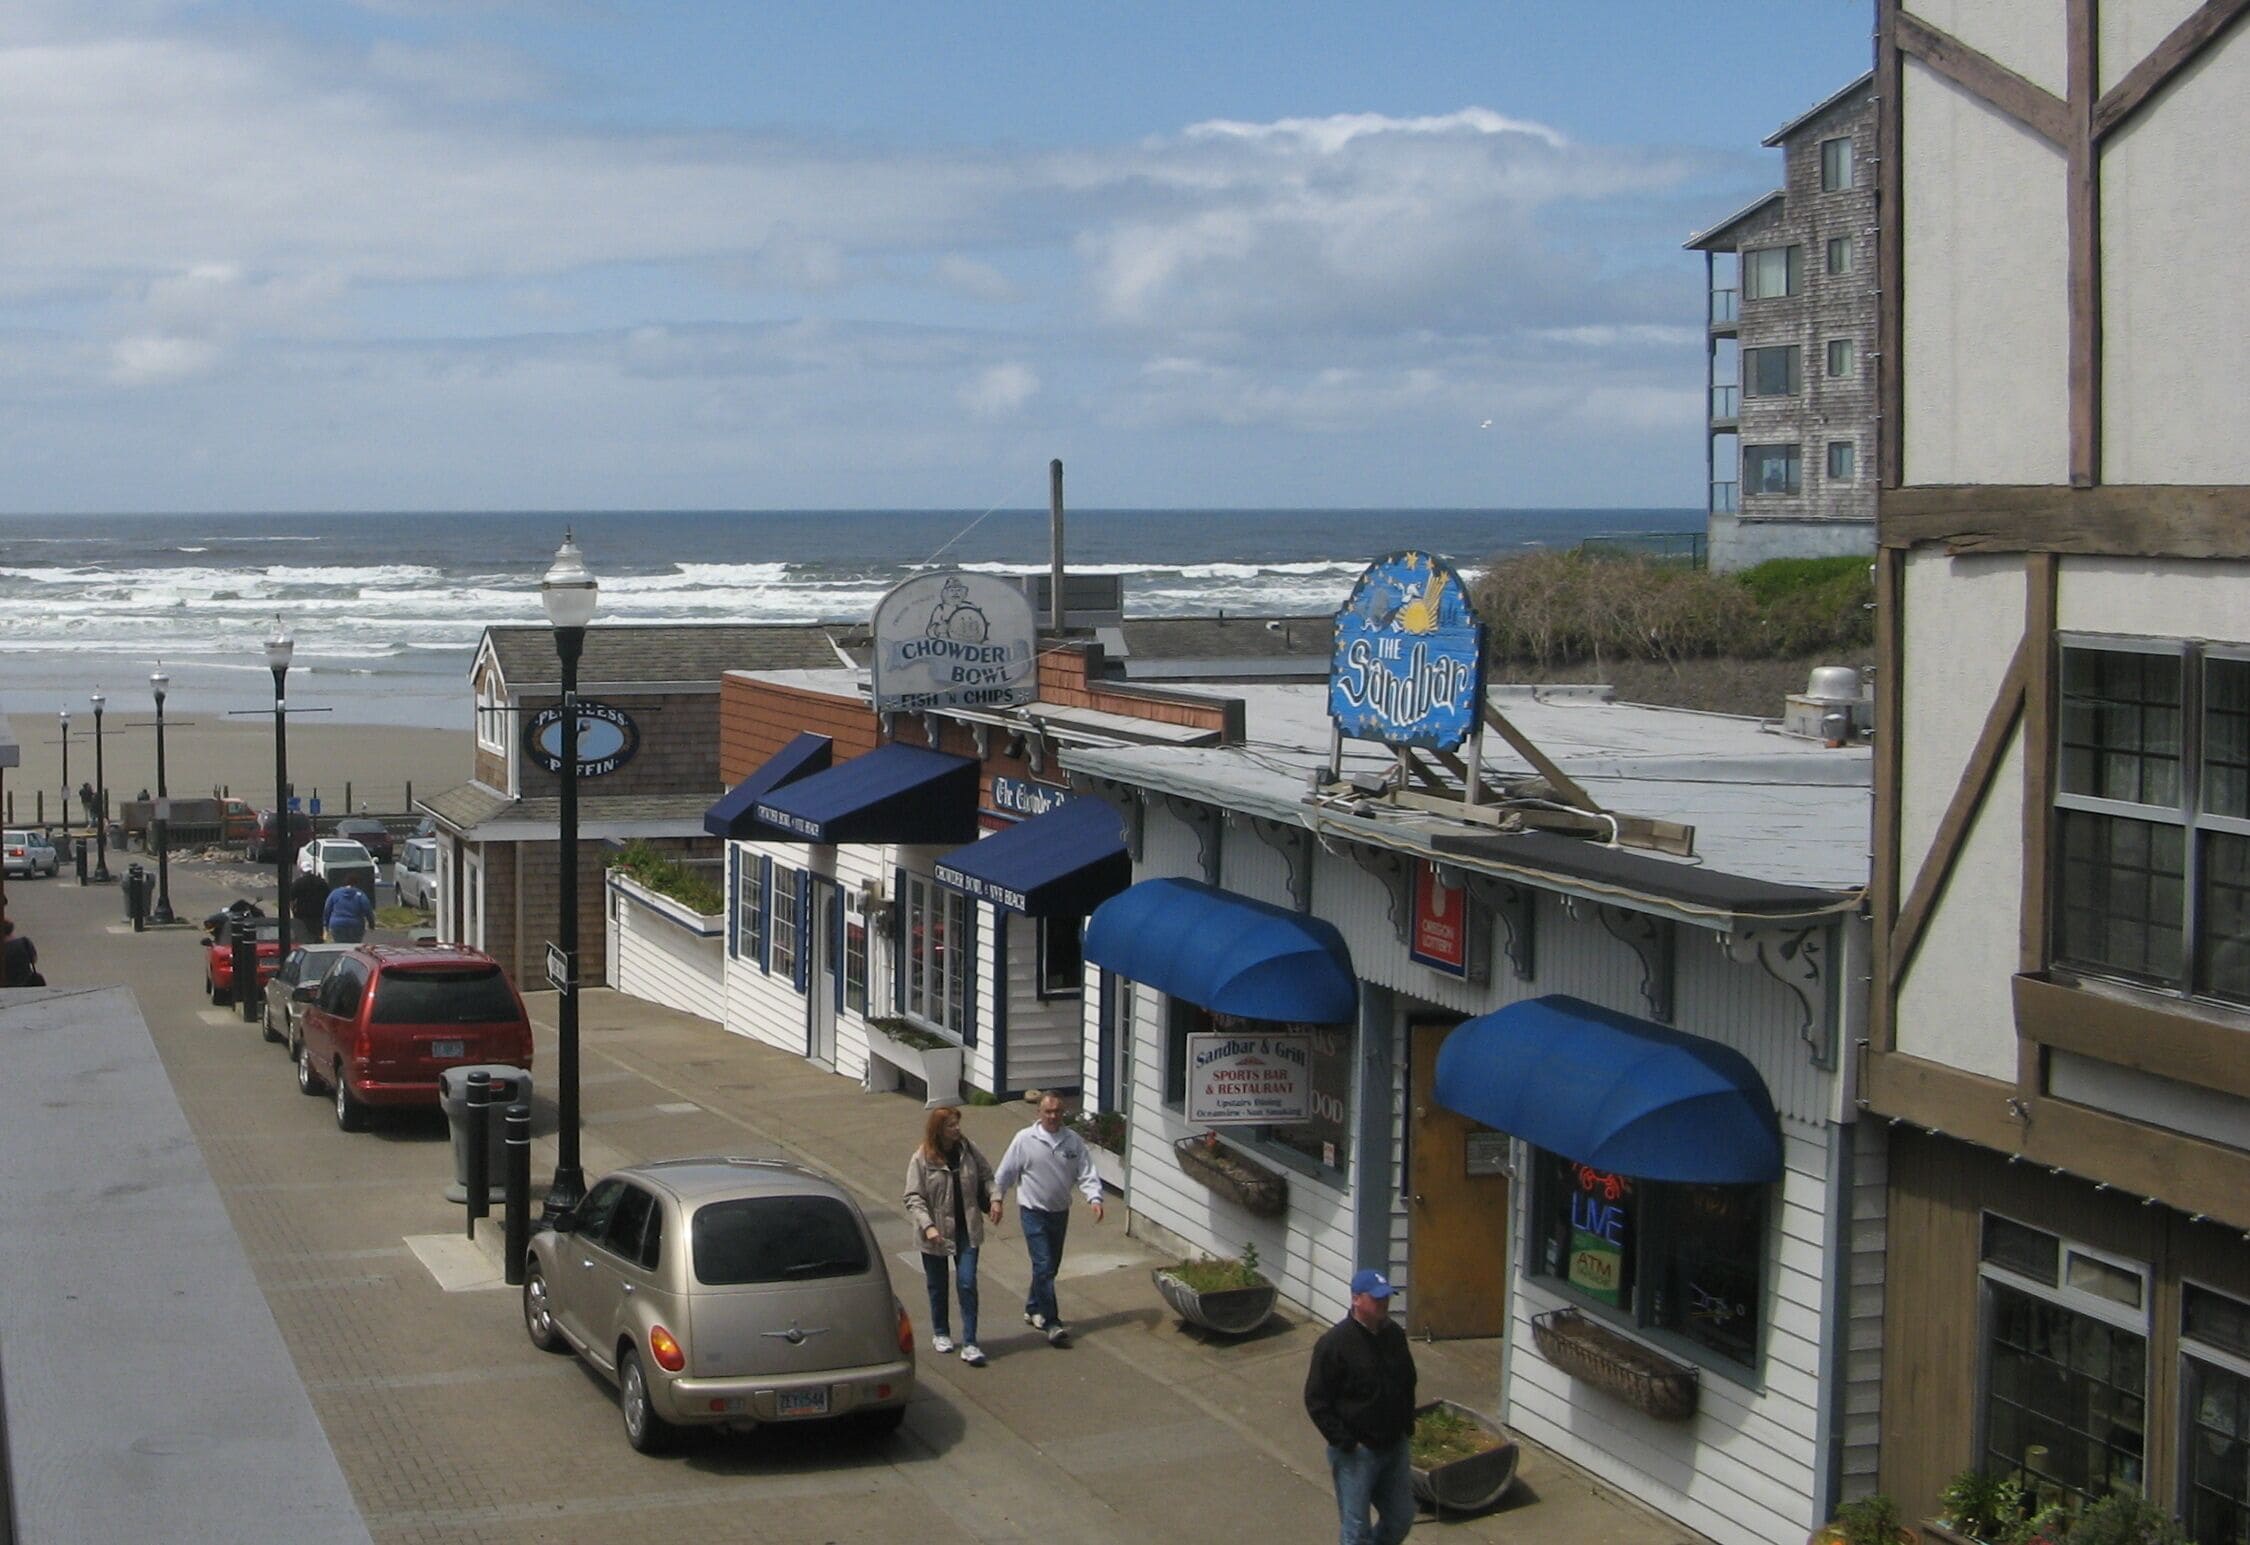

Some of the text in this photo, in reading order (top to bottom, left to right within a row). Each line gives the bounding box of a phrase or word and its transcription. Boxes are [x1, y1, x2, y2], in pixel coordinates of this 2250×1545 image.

[902, 639, 1005, 663] CHOWDER
[1379, 637, 1401, 659] THE
[952, 665, 1012, 685] BOWL
[1337, 638, 1468, 727] Sandbar
[901, 693, 938, 708] FISH
[963, 688, 1013, 704] CHIPS
[539, 703, 625, 725] PELESS
[550, 758, 614, 776] PFFIN
[1196, 1039, 1256, 1068] Sandbar
[1260, 1039, 1269, 1054] &
[1275, 1042, 1305, 1067] Grill
[1212, 1069, 1288, 1081] SPORTS BAR
[1205, 1083, 1294, 1095] & RESTAURANT
[1572, 1190, 1624, 1248] LIVE
[1576, 1251, 1612, 1279] ATM
